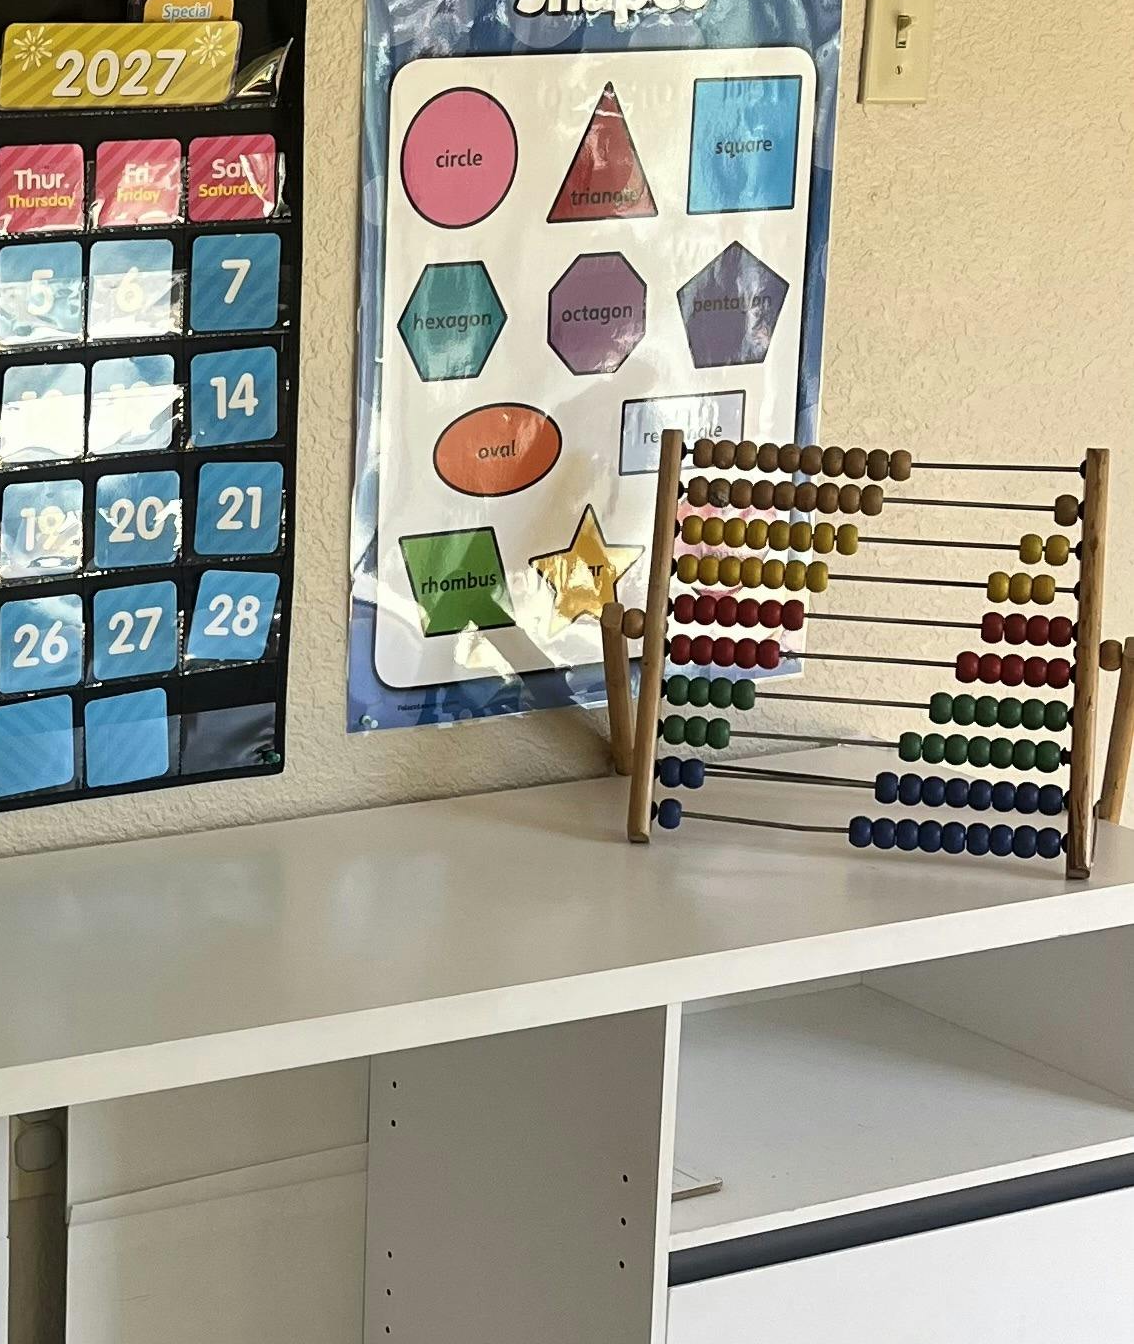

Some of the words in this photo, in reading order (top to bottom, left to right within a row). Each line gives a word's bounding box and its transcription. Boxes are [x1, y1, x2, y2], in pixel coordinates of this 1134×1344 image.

[162, 1, 213, 23] Special
[51, 48, 188, 98] 2027
[13, 170, 69, 190] Thur.
[435, 149, 483, 169] circle
[571, 187, 638, 208] triangle
[715, 139, 772, 158] square
[7, 194, 75, 210] Thursday
[198, 181, 266, 198] Saturday
[27, 269, 53, 316] 5
[117, 266, 143, 313] 6
[221, 259, 251, 305] 7
[413, 313, 492, 333] hexagon
[561, 302, 633, 323] octagon
[693, 295, 772, 318] pentagon
[209, 372, 259, 420] 14
[477, 440, 517, 461] oval
[20, 506, 65, 551] 19
[109, 496, 165, 542] 20
[217, 485, 262, 530] 21
[420, 571, 497, 594] rhombus
[12, 623, 69, 667] 26
[107, 607, 162, 653] 27
[204, 593, 260, 636] 28
